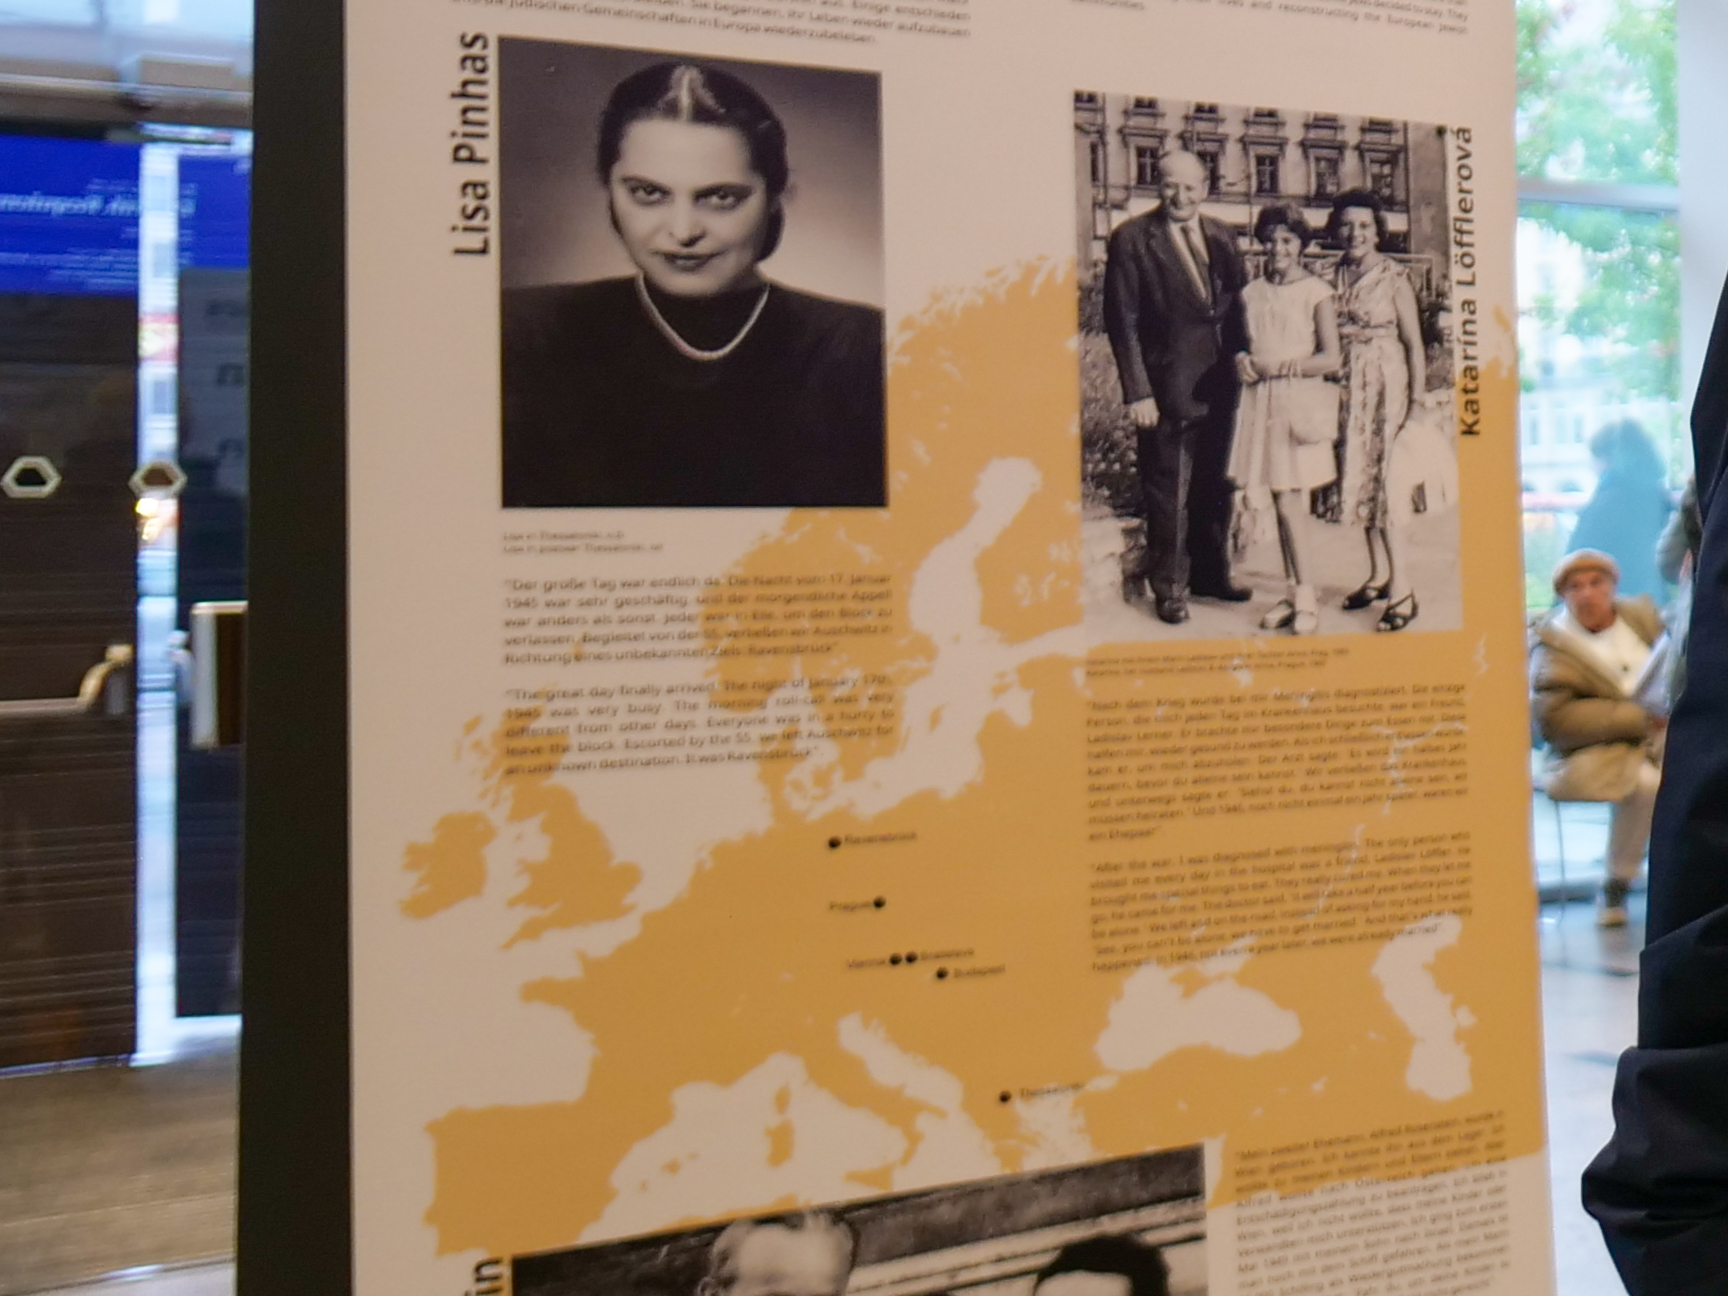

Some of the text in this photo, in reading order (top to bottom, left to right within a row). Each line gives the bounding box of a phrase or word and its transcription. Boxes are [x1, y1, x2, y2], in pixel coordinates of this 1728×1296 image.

[450, 31, 490, 255] Lisa Pinhas
[1451, 125, 1481, 437] Katarína Löfflerová
